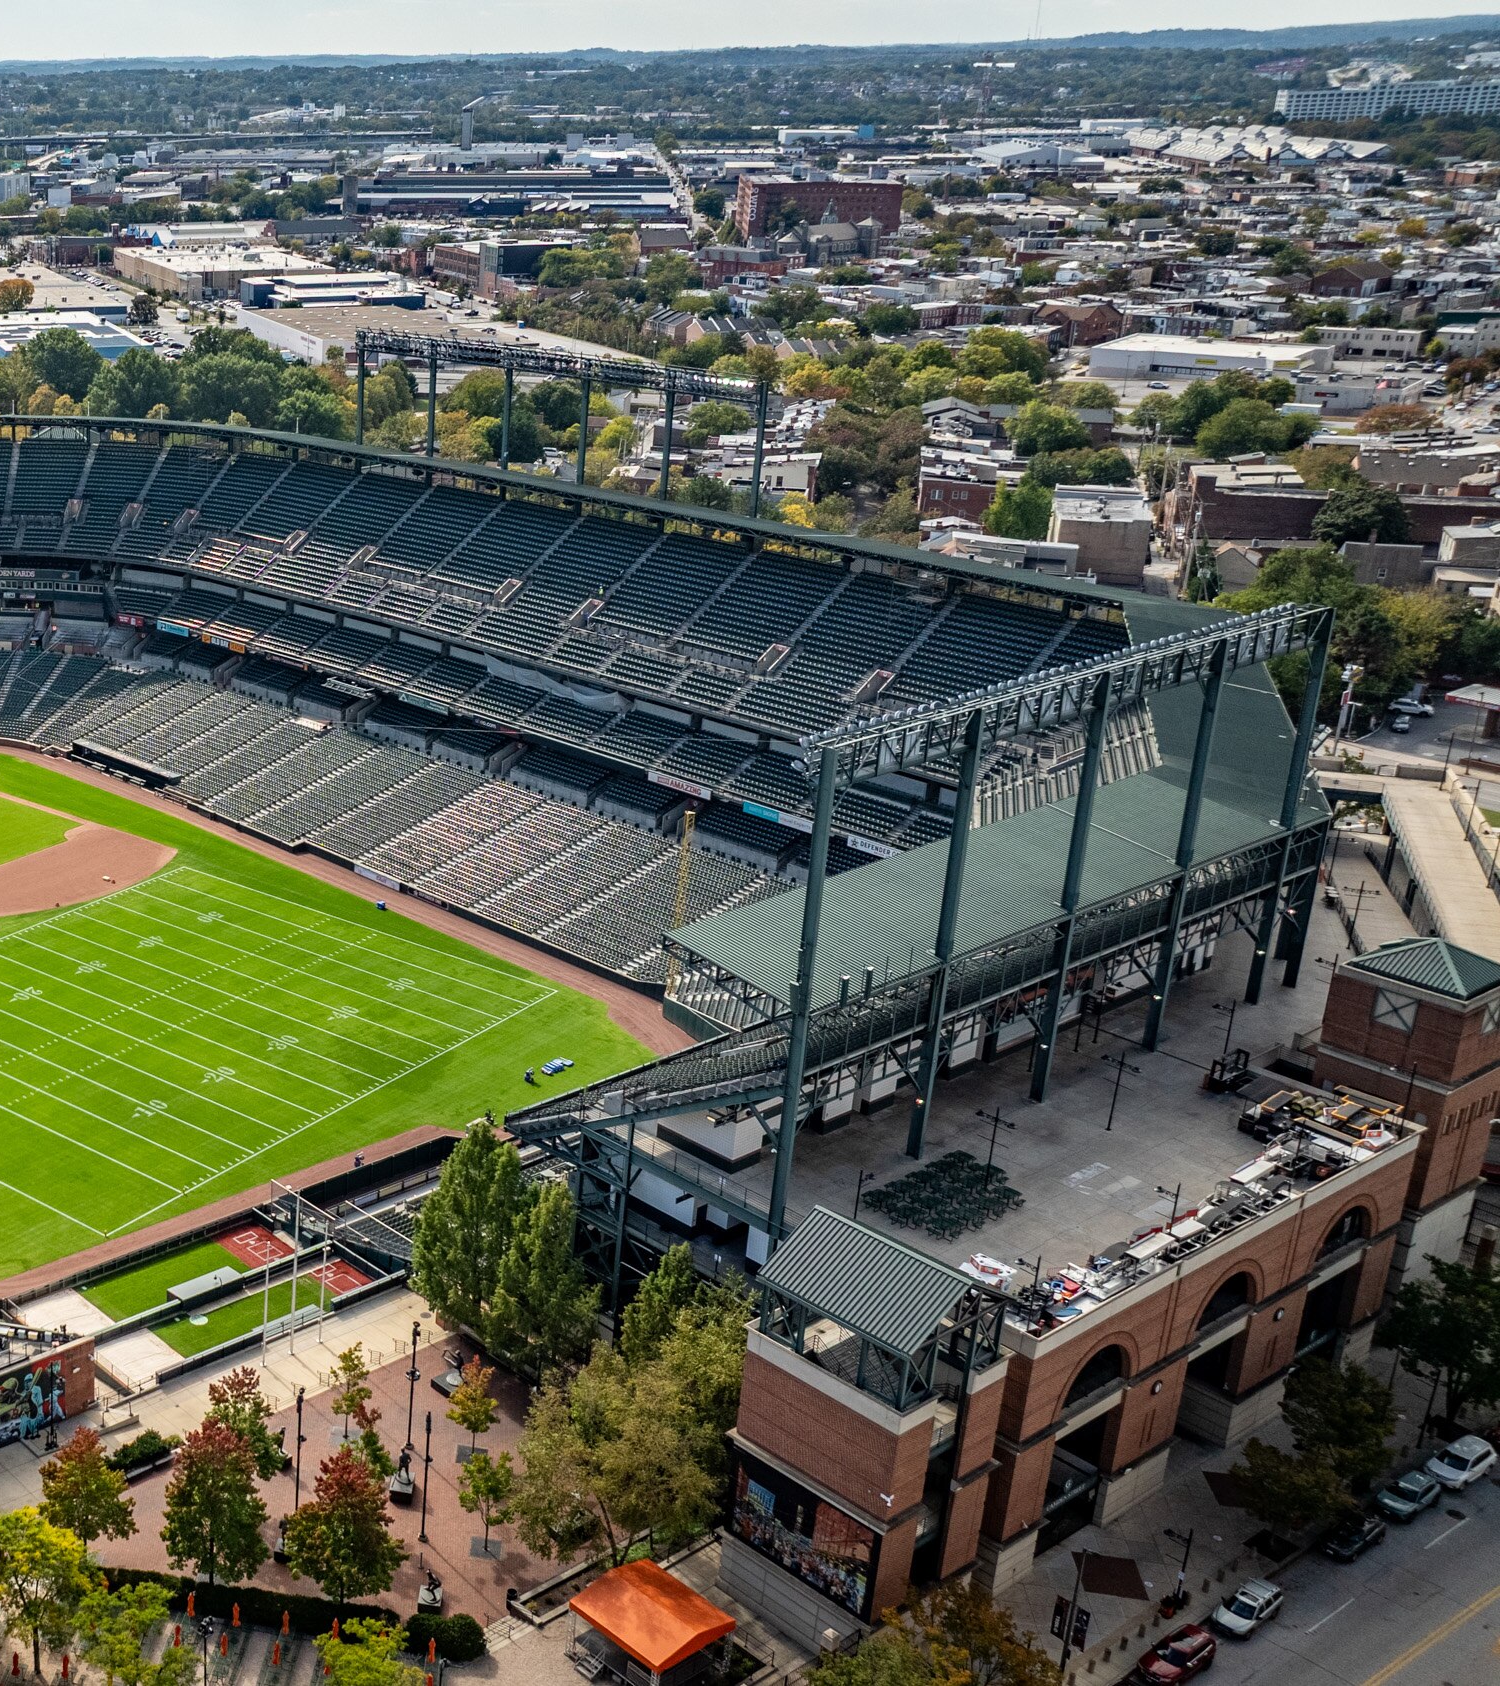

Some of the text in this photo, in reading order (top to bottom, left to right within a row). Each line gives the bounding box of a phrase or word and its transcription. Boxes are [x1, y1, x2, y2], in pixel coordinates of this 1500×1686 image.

[13, 570, 36, 578] YARDS
[670, 780, 701, 796] AMAZING
[860, 840, 891, 856] DEFENDER
[16, 986, 43, 1000] 20
[207, 1066, 235, 1083] 20
[140, 1099, 167, 1118] 10
